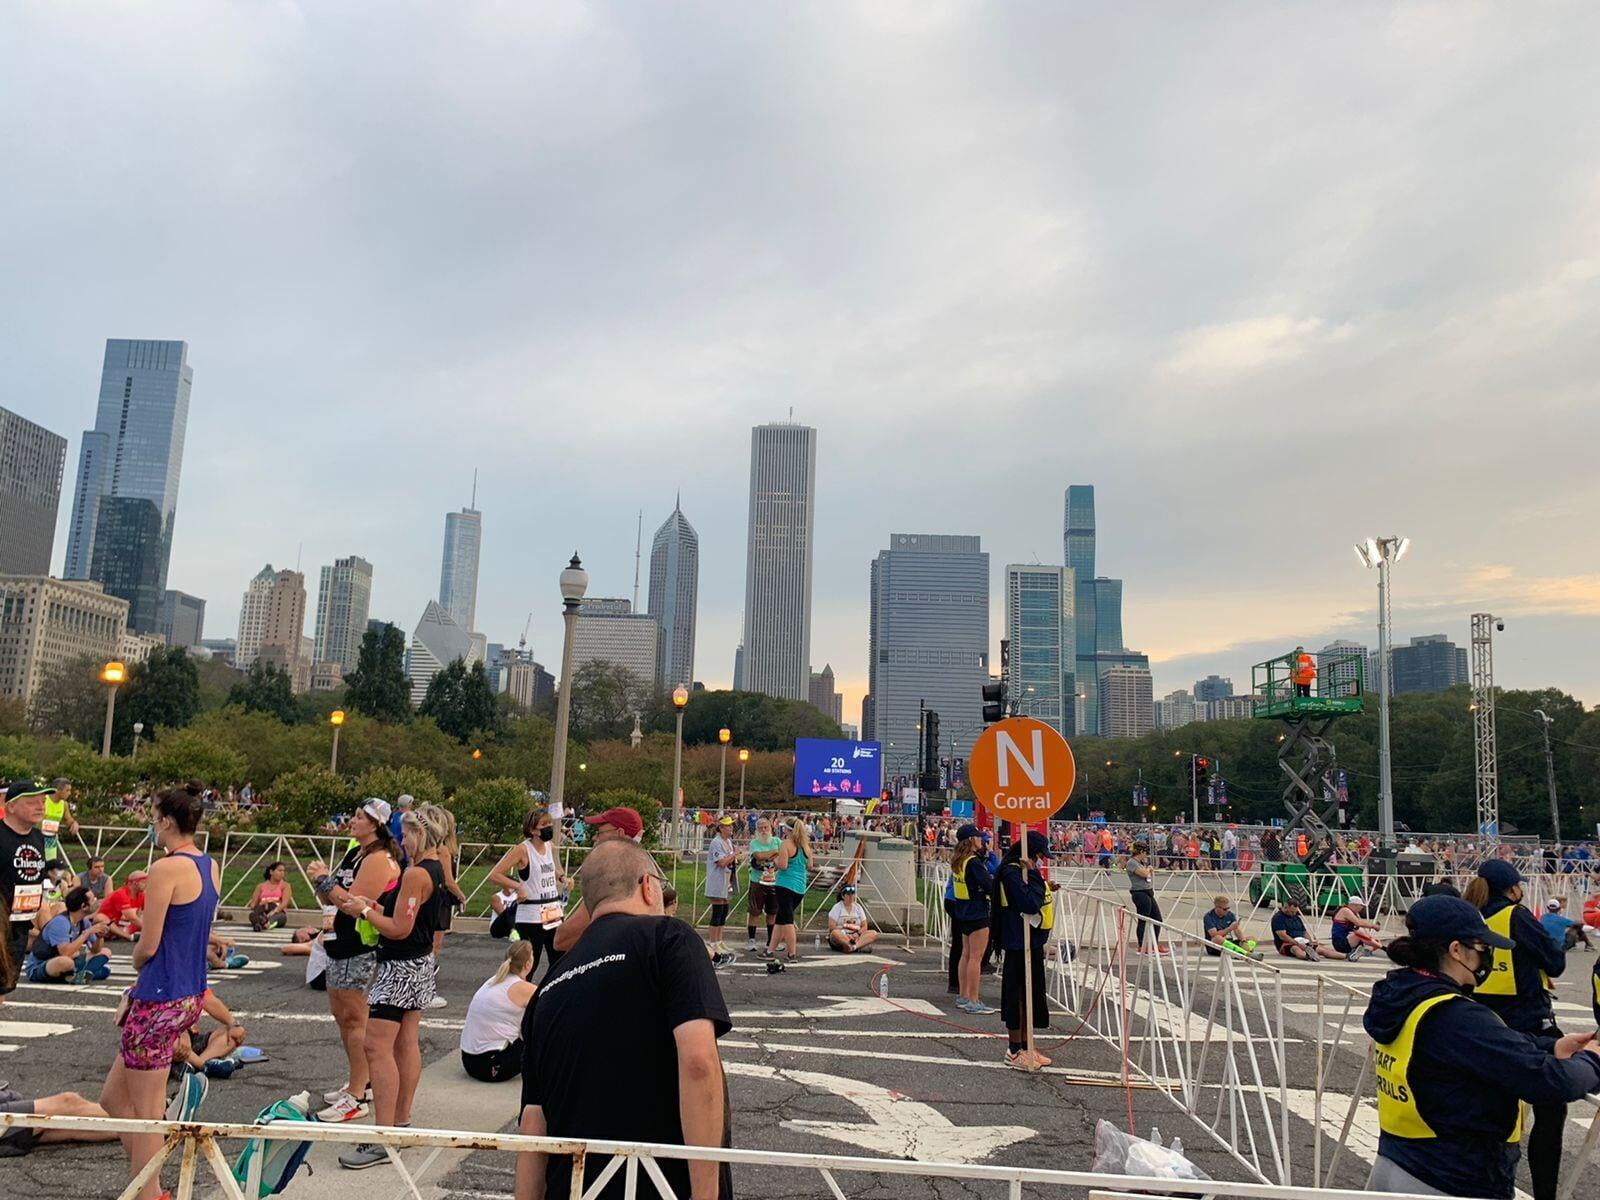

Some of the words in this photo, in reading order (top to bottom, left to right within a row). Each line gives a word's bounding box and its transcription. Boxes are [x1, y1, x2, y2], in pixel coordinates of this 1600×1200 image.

[831, 757, 845, 769] 20
[996, 730, 1045, 787] N
[993, 791, 1051, 809] Corral
